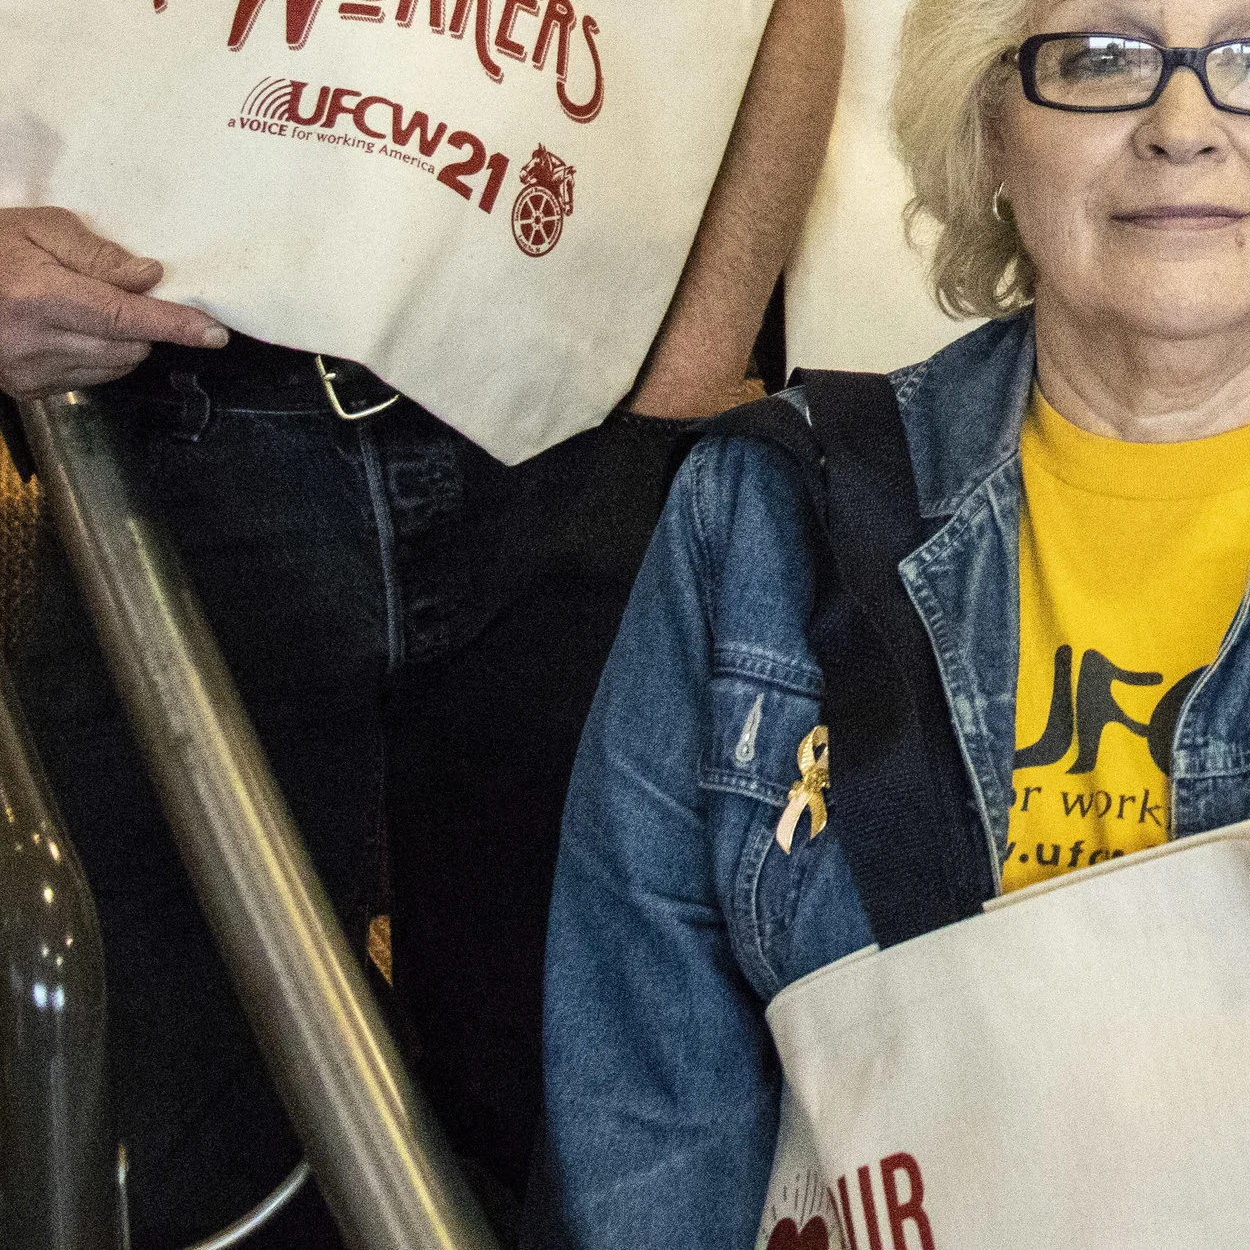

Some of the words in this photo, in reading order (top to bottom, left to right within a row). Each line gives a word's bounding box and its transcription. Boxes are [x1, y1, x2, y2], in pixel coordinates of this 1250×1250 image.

[227, 117, 237, 130] a
[239, 117, 288, 138] VOICE
[292, 126, 314, 142] for
[316, 133, 376, 154] working
[378, 143, 436, 176] America
